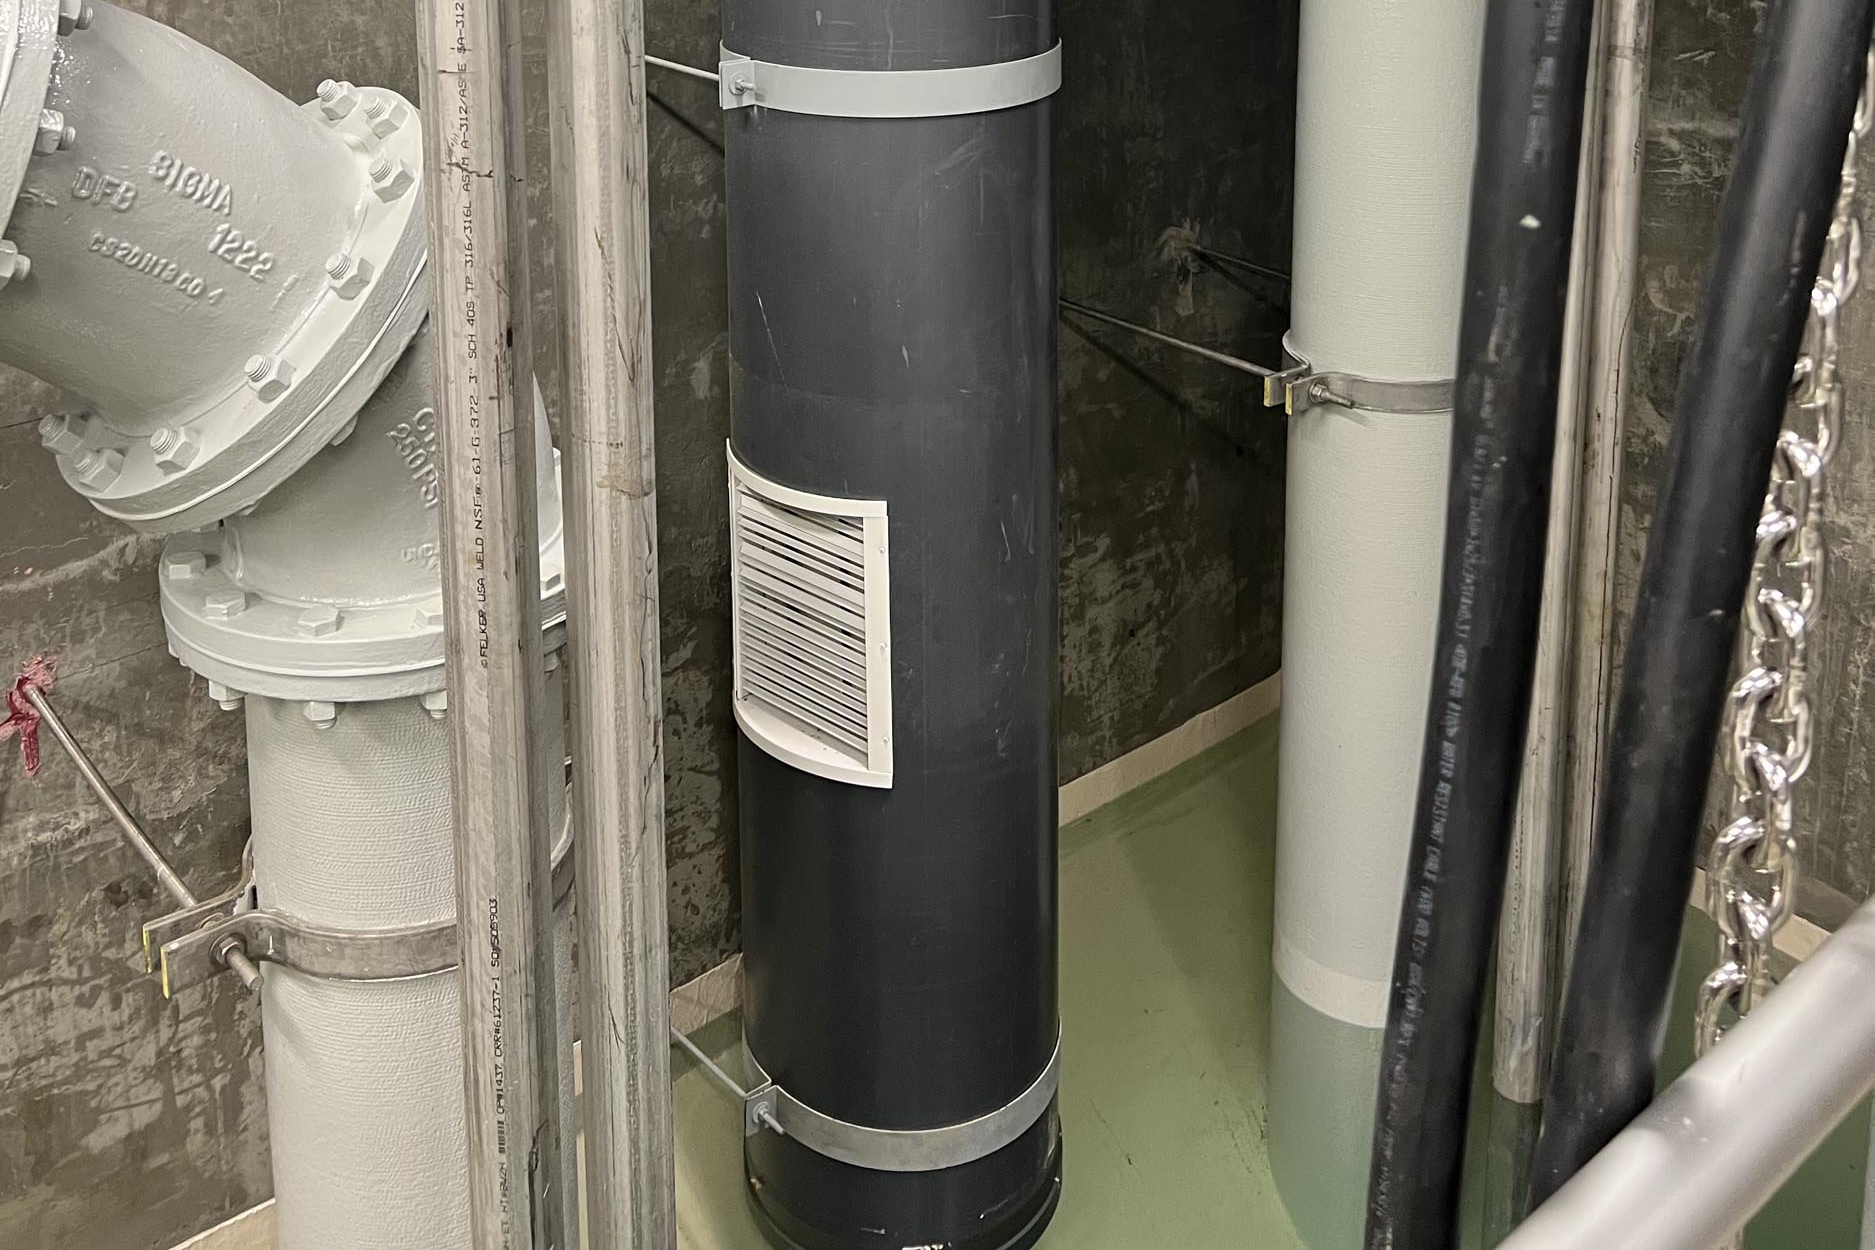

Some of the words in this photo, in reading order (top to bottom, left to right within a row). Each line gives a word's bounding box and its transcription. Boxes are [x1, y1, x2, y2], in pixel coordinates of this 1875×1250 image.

[148, 150, 232, 216] SIGMA
[462, 157, 471, 192] ASTM
[462, 200, 474, 268] 316/316L
[207, 223, 274, 281] 1222
[465, 276, 474, 292] TP
[466, 300, 476, 326] 40S
[467, 334, 477, 359] SCH
[475, 537, 484, 570] WELD
[476, 577, 486, 602] USA
[1430, 780, 1452, 844] RESISTANT
[492, 976, 502, 1058] CRR#61237-1
